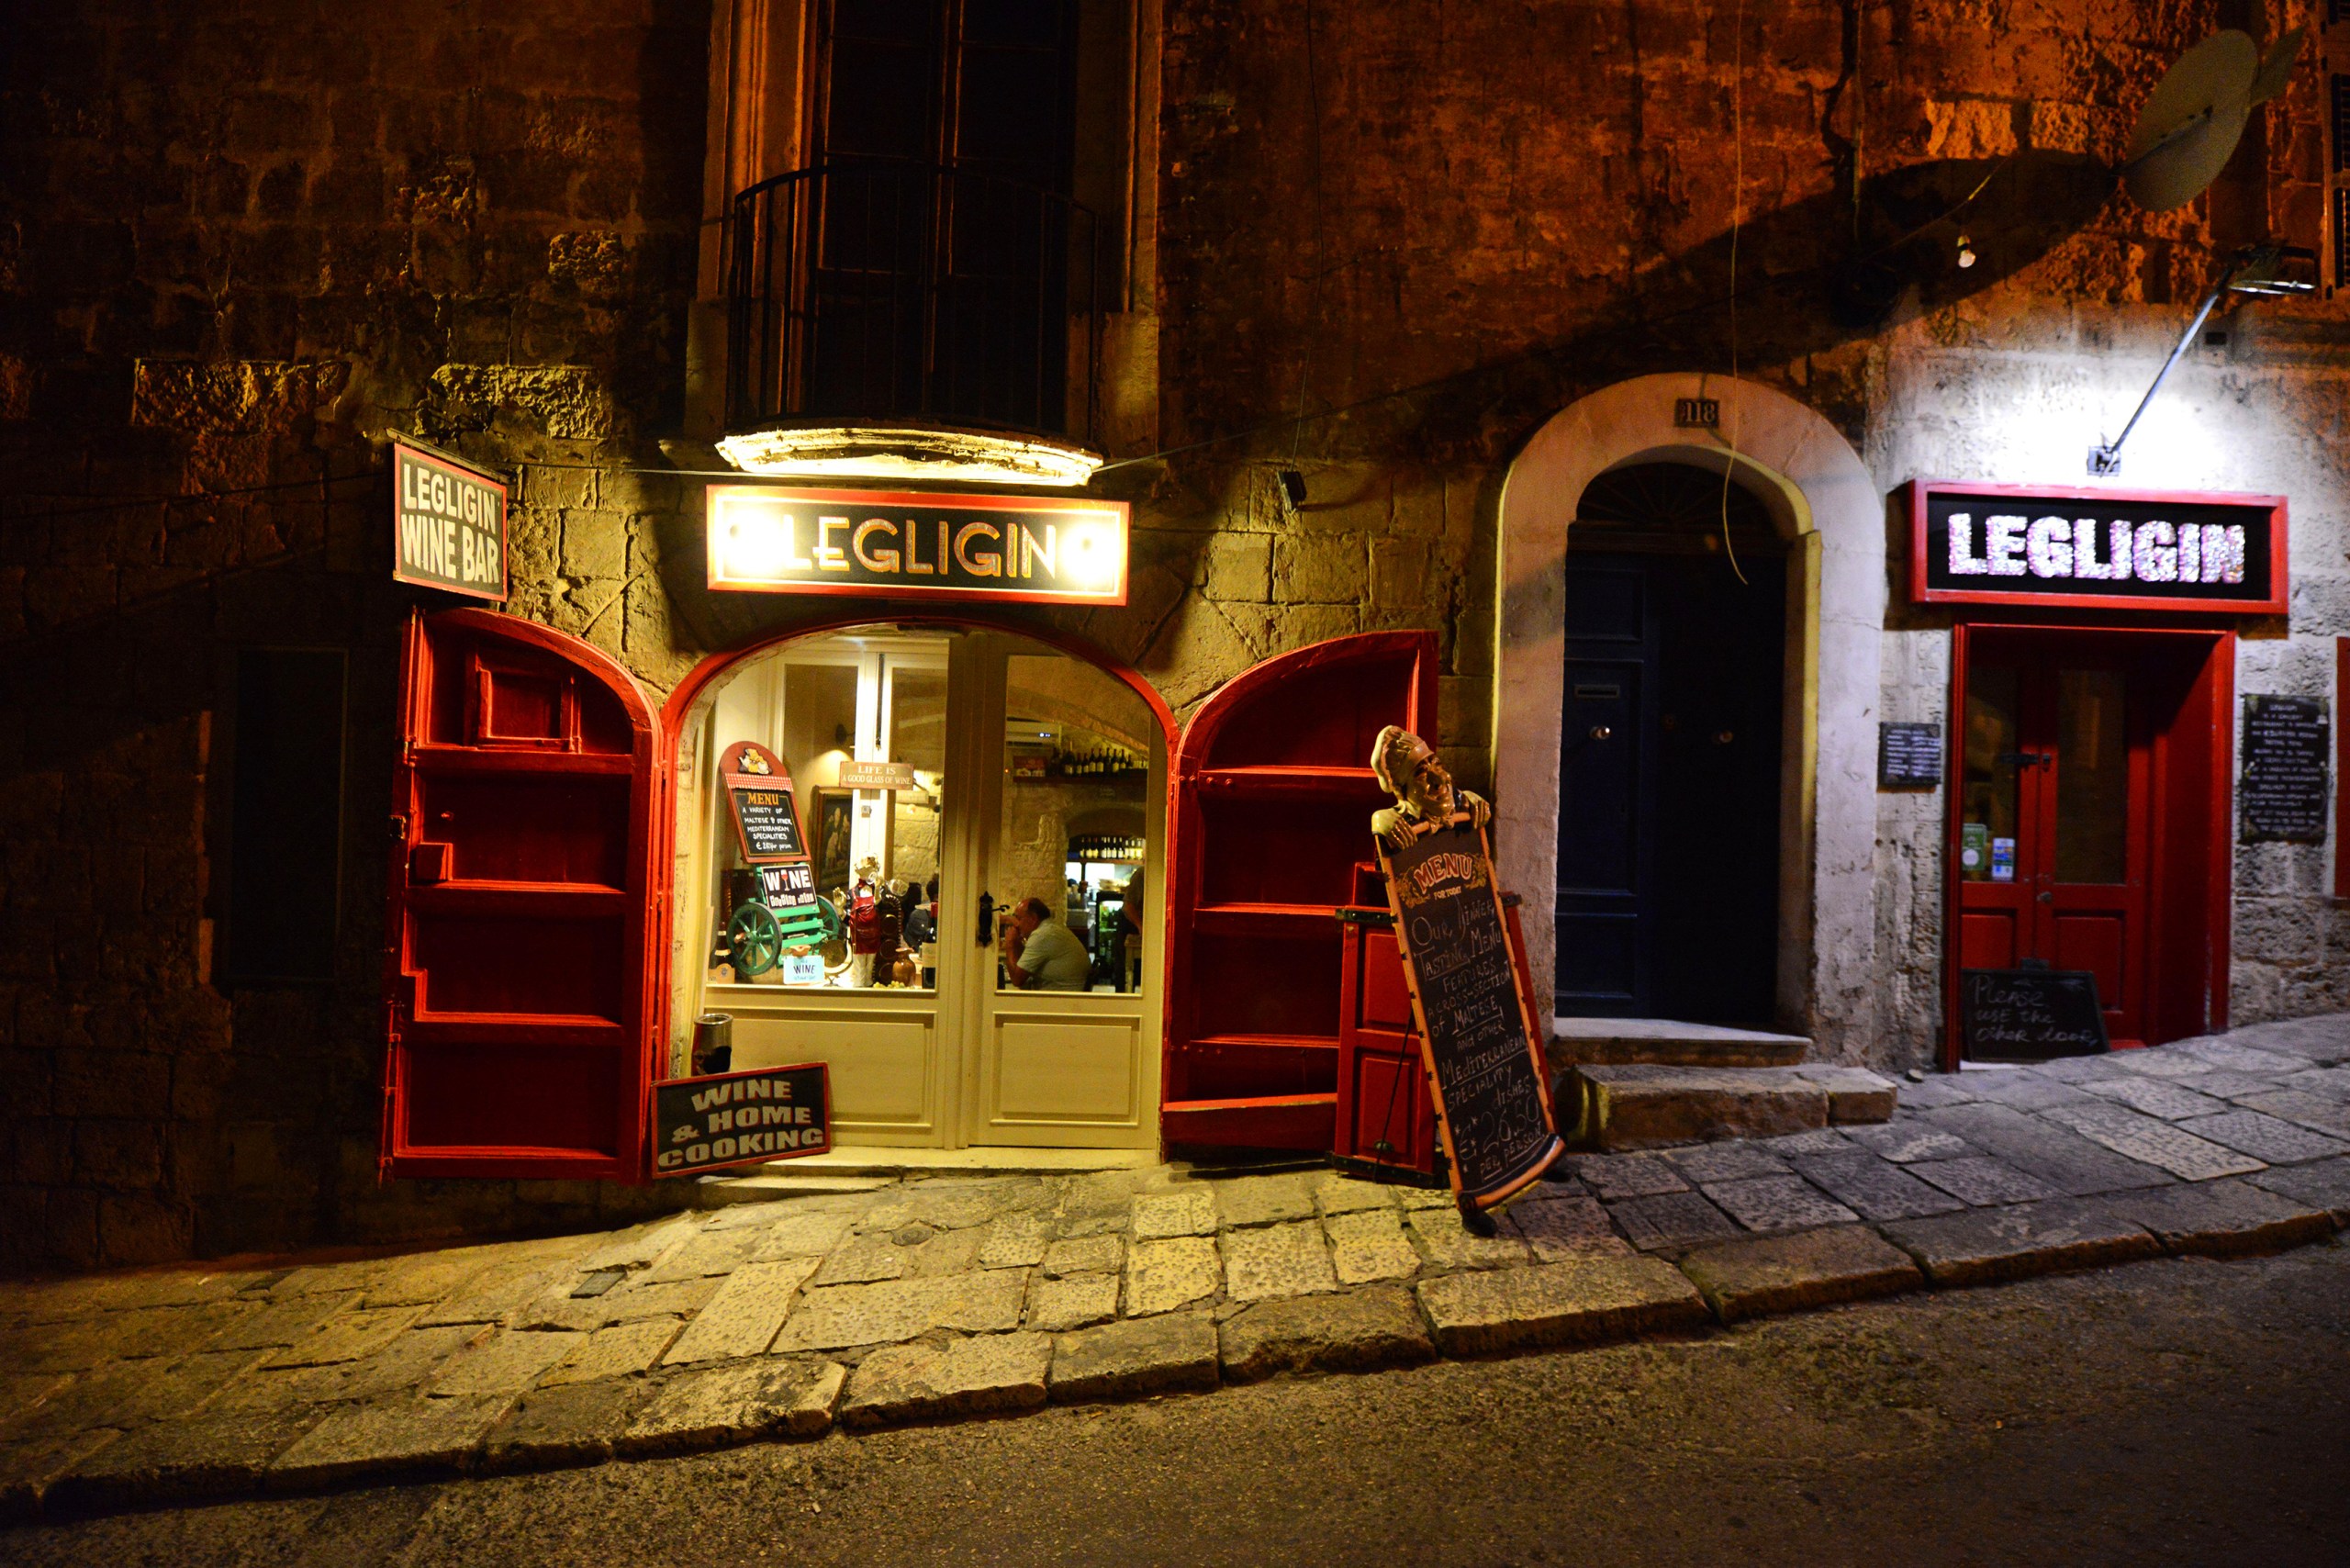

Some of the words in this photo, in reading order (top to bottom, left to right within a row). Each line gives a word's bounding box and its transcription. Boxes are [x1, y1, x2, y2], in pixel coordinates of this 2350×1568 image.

[404, 464, 496, 534] LEGLIGIN
[401, 514, 456, 579] WINE
[462, 526, 499, 584] BAR
[781, 513, 1057, 578] LEGLIGIN
[1948, 513, 2245, 584] LEGLIGIN
[847, 775, 865, 783] GOOD
[867, 775, 884, 783] GLASS
[858, 766, 882, 774] LIFE
[886, 767, 896, 775] IS
[747, 792, 779, 805] MENU
[1414, 853, 1472, 894] MENU
[1434, 890, 1447, 900] FOR
[793, 965, 815, 974] WINE
[691, 1079, 792, 1112] WINE
[672, 1125, 699, 1143] &
[708, 1106, 811, 1134] HOME
[658, 1128, 823, 1168] COOKING
